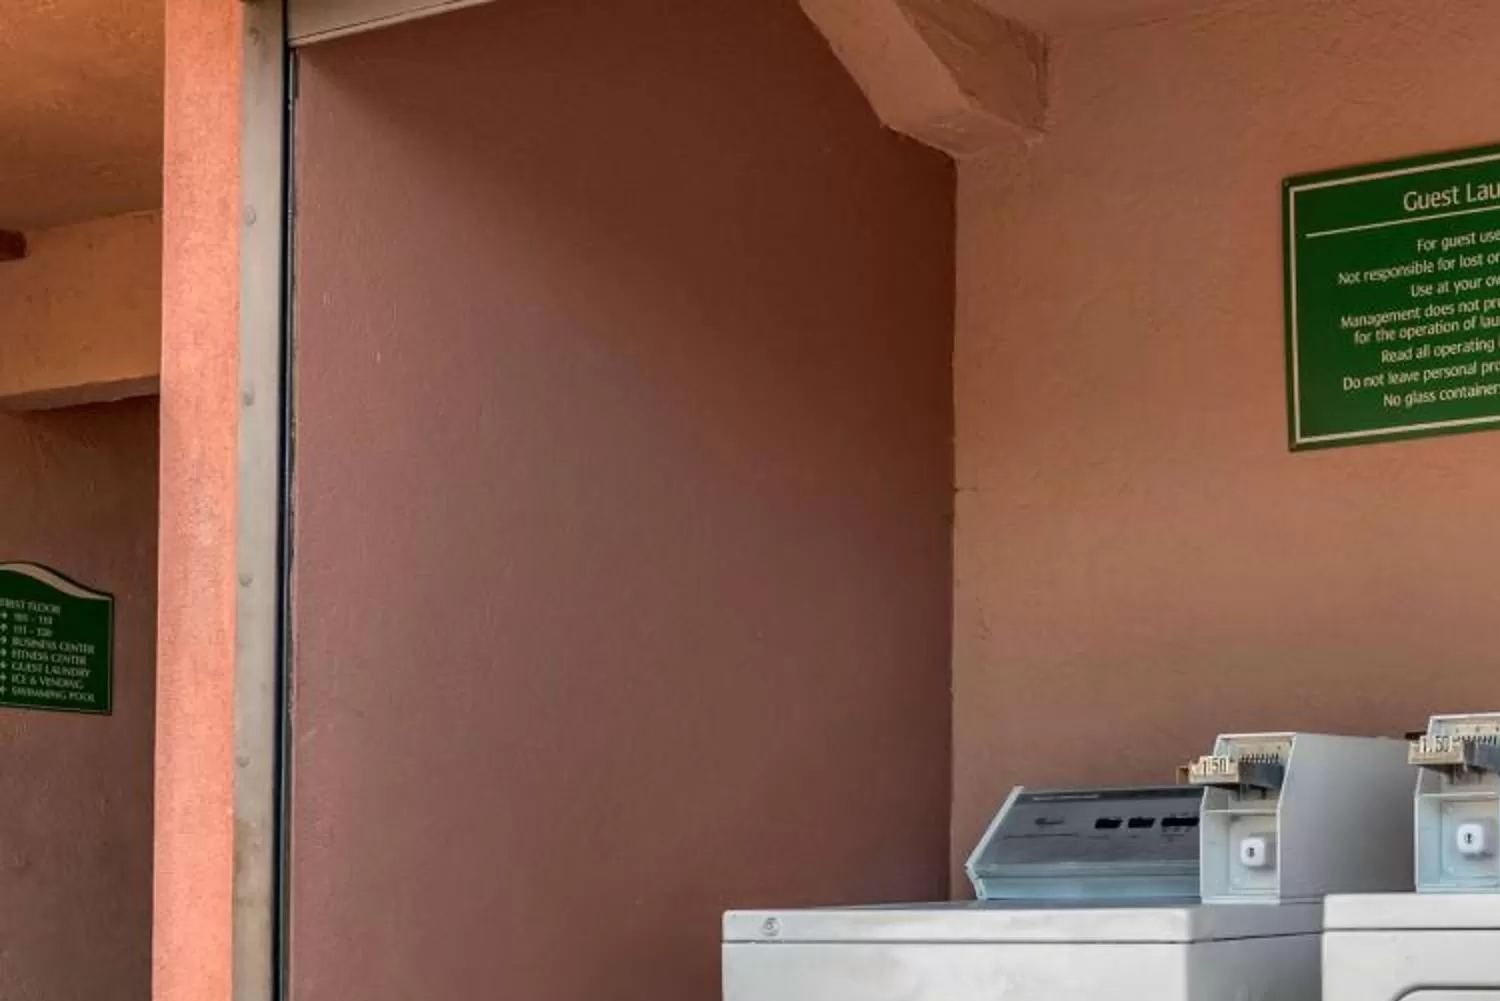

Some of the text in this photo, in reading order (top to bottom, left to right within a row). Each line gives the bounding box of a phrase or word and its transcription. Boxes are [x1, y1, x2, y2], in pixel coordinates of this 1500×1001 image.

[1403, 184, 1460, 212] Guest
[1417, 238, 1437, 252] For
[1441, 231, 1476, 250] guest
[1338, 270, 1360, 285] Not
[1363, 260, 1435, 283] responsible
[1437, 256, 1456, 272] for
[1459, 251, 1483, 268] lost
[1487, 252, 1500, 264] or
[1411, 282, 1433, 297] Use
[1437, 281, 1450, 293] at
[1453, 278, 1482, 294] your
[1340, 307, 1422, 330] Management
[1424, 302, 1455, 319] does
[1457, 299, 1480, 313] not
[1354, 330, 1372, 345] for
[1375, 326, 1397, 342] the
[1400, 319, 1460, 342] operation
[1463, 315, 1478, 329] of
[1381, 346, 1413, 363] Read
[1415, 344, 1431, 359] all
[1433, 337, 1496, 360] operating
[1343, 376, 1361, 391] Do
[1363, 373, 1386, 388] not
[1387, 367, 1421, 386] leave
[1423, 358, 1478, 382] personal
[1383, 392, 1401, 407] No
[1405, 387, 1437, 408] glass
[12, 637, 95, 654] BUSINESS CENTER
[11, 649, 87, 665] FITNESS CENTER
[12, 662, 91, 677] GUEST LAUNDRY
[12, 673, 84, 689] ICE & VENDING
[12, 686, 95, 702] SWIMMING POOL
